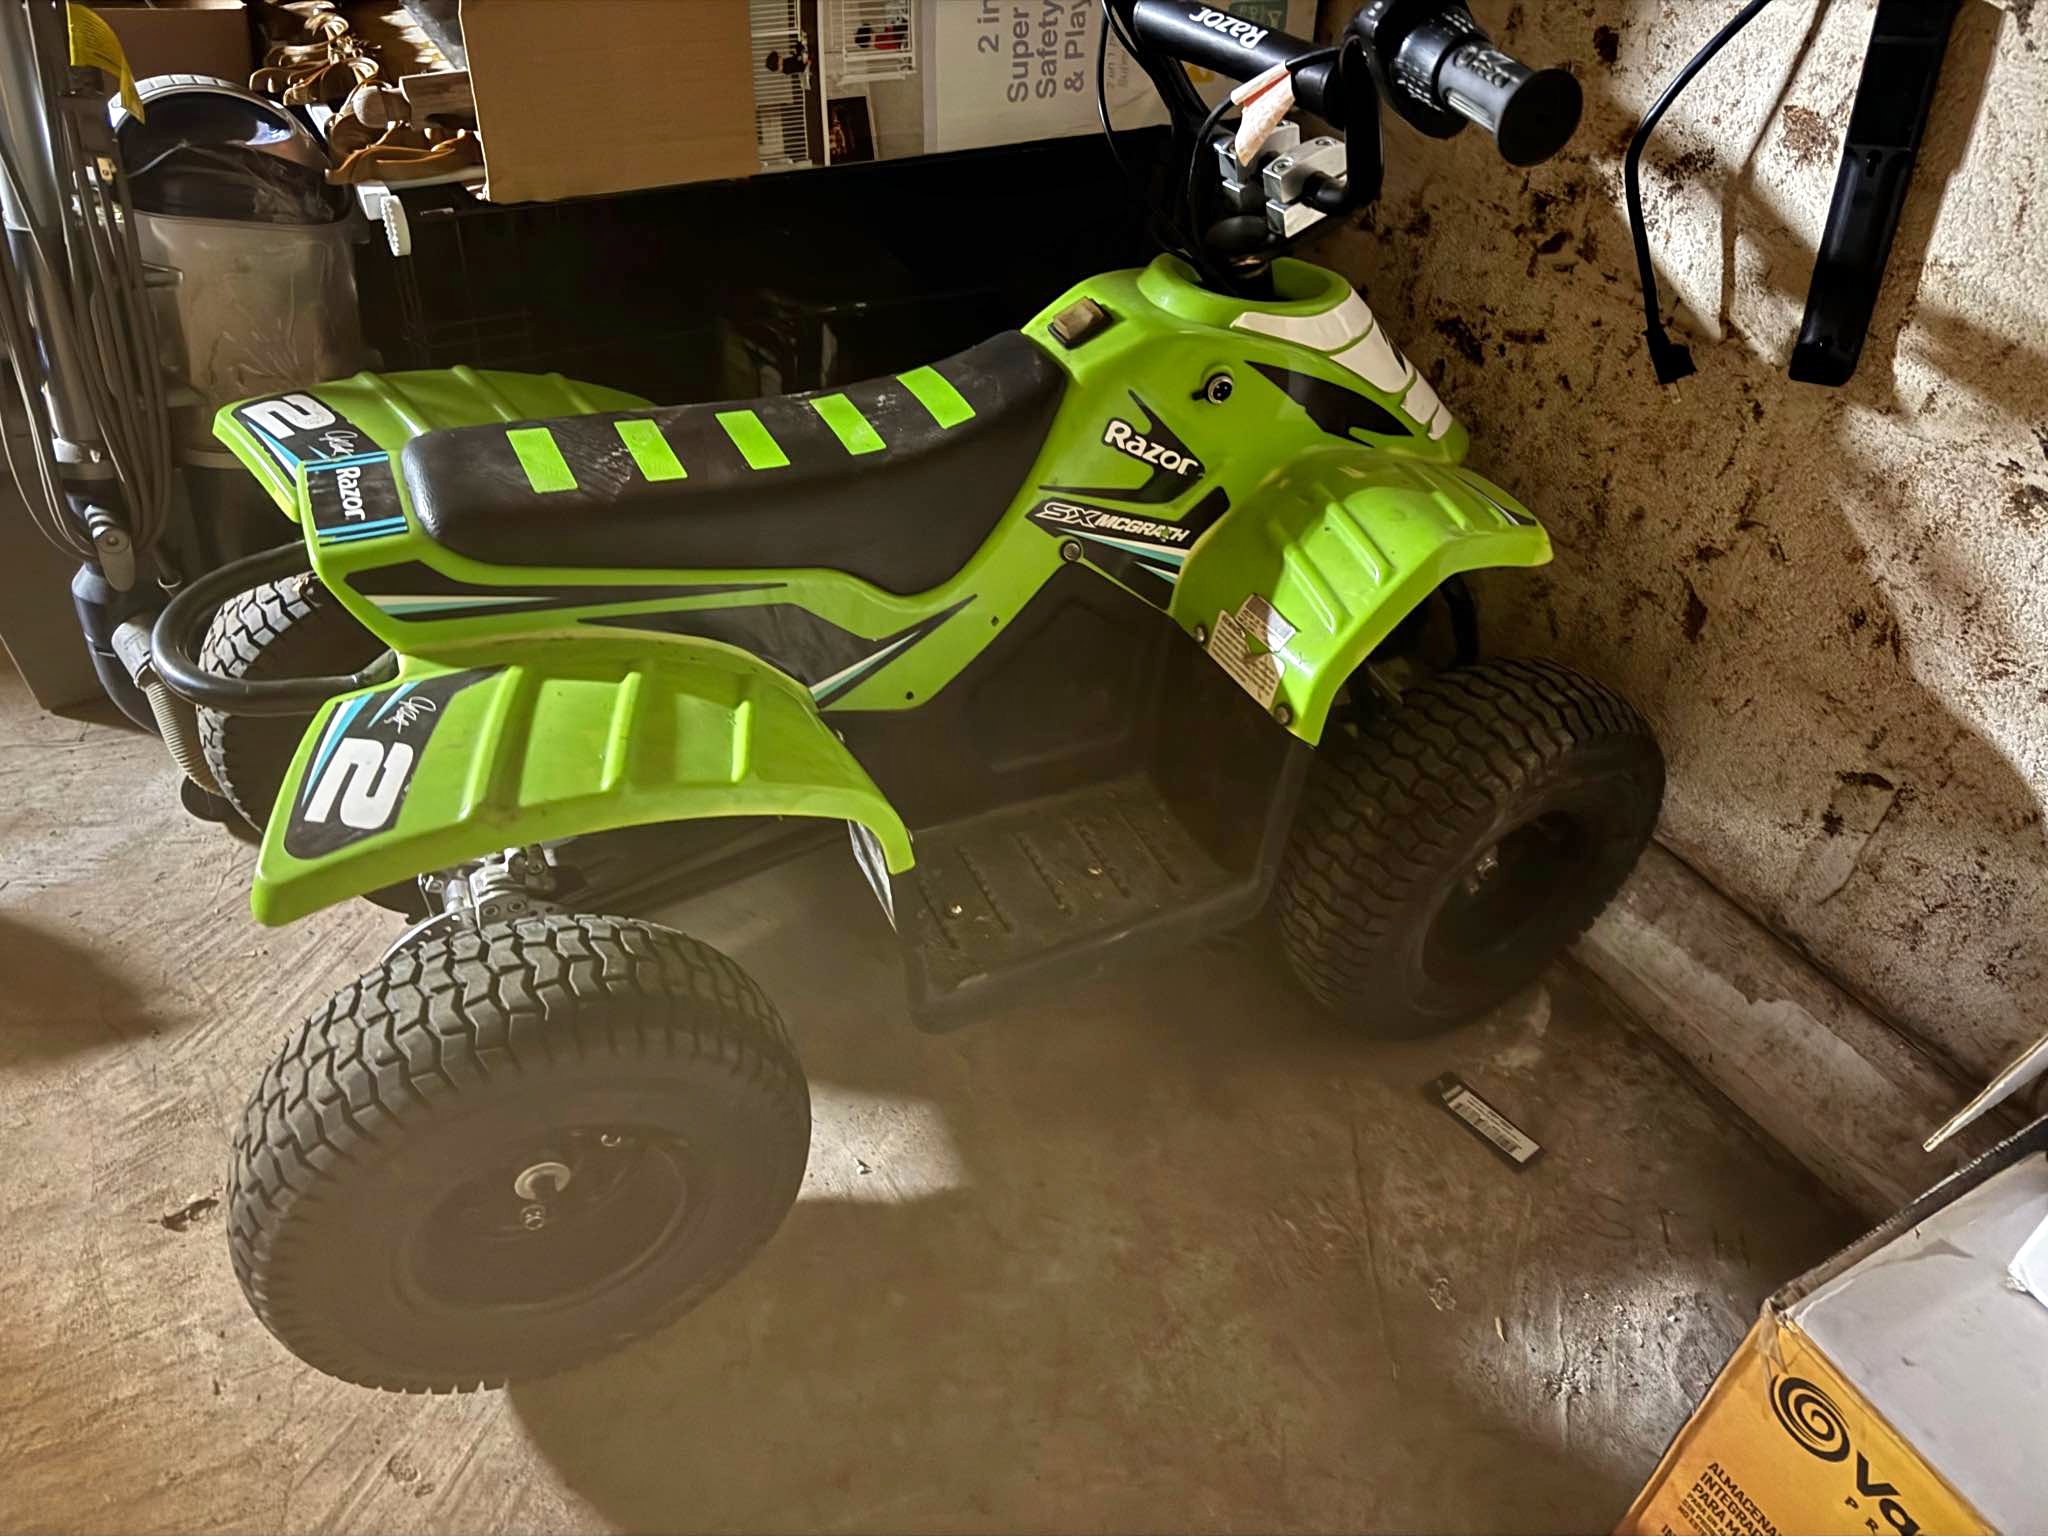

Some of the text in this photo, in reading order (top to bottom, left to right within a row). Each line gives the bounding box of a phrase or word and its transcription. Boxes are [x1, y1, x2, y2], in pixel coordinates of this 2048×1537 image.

[978, 34, 999, 53] 2
[1007, 7, 1034, 103] Super
[1036, 0, 1064, 99] Safety
[1188, 6, 1269, 49] Razor
[1064, 70, 1084, 92] &
[241, 394, 336, 439] 2
[1104, 420, 1198, 475] Razor
[335, 466, 366, 521] Razor
[1034, 502, 1103, 528] SX
[304, 737, 413, 829] 2
[1692, 1483, 1726, 1522] PARA
[1707, 1462, 1782, 1536] ALMACENA
[1857, 1449, 1924, 1536] Va
